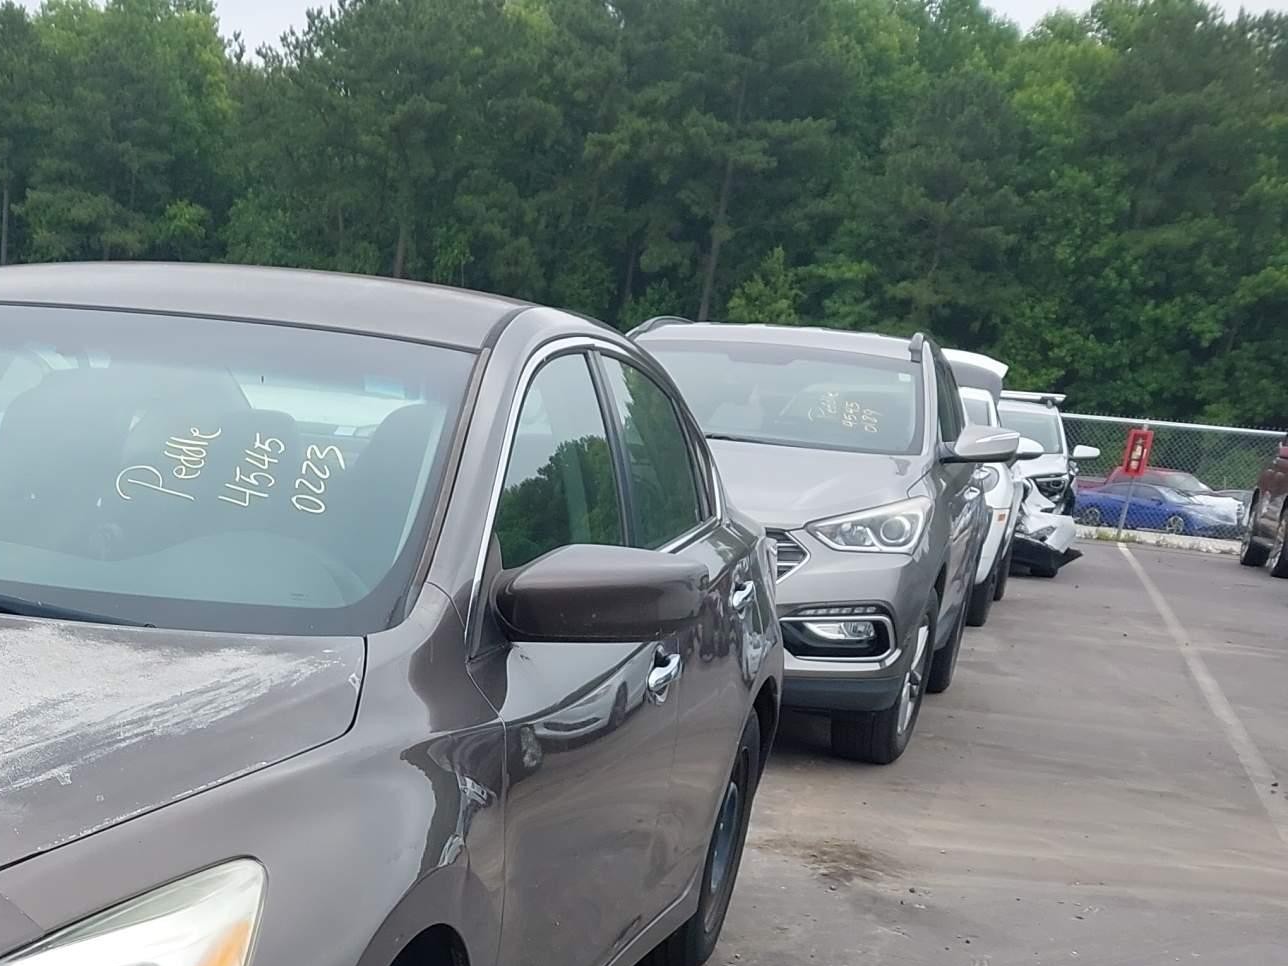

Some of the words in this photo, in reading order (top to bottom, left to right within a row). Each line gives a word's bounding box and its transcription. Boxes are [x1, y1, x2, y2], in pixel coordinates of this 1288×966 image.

[115, 426, 222, 501] Peddle
[217, 432, 285, 507] 4545
[291, 444, 346, 514] 0223
